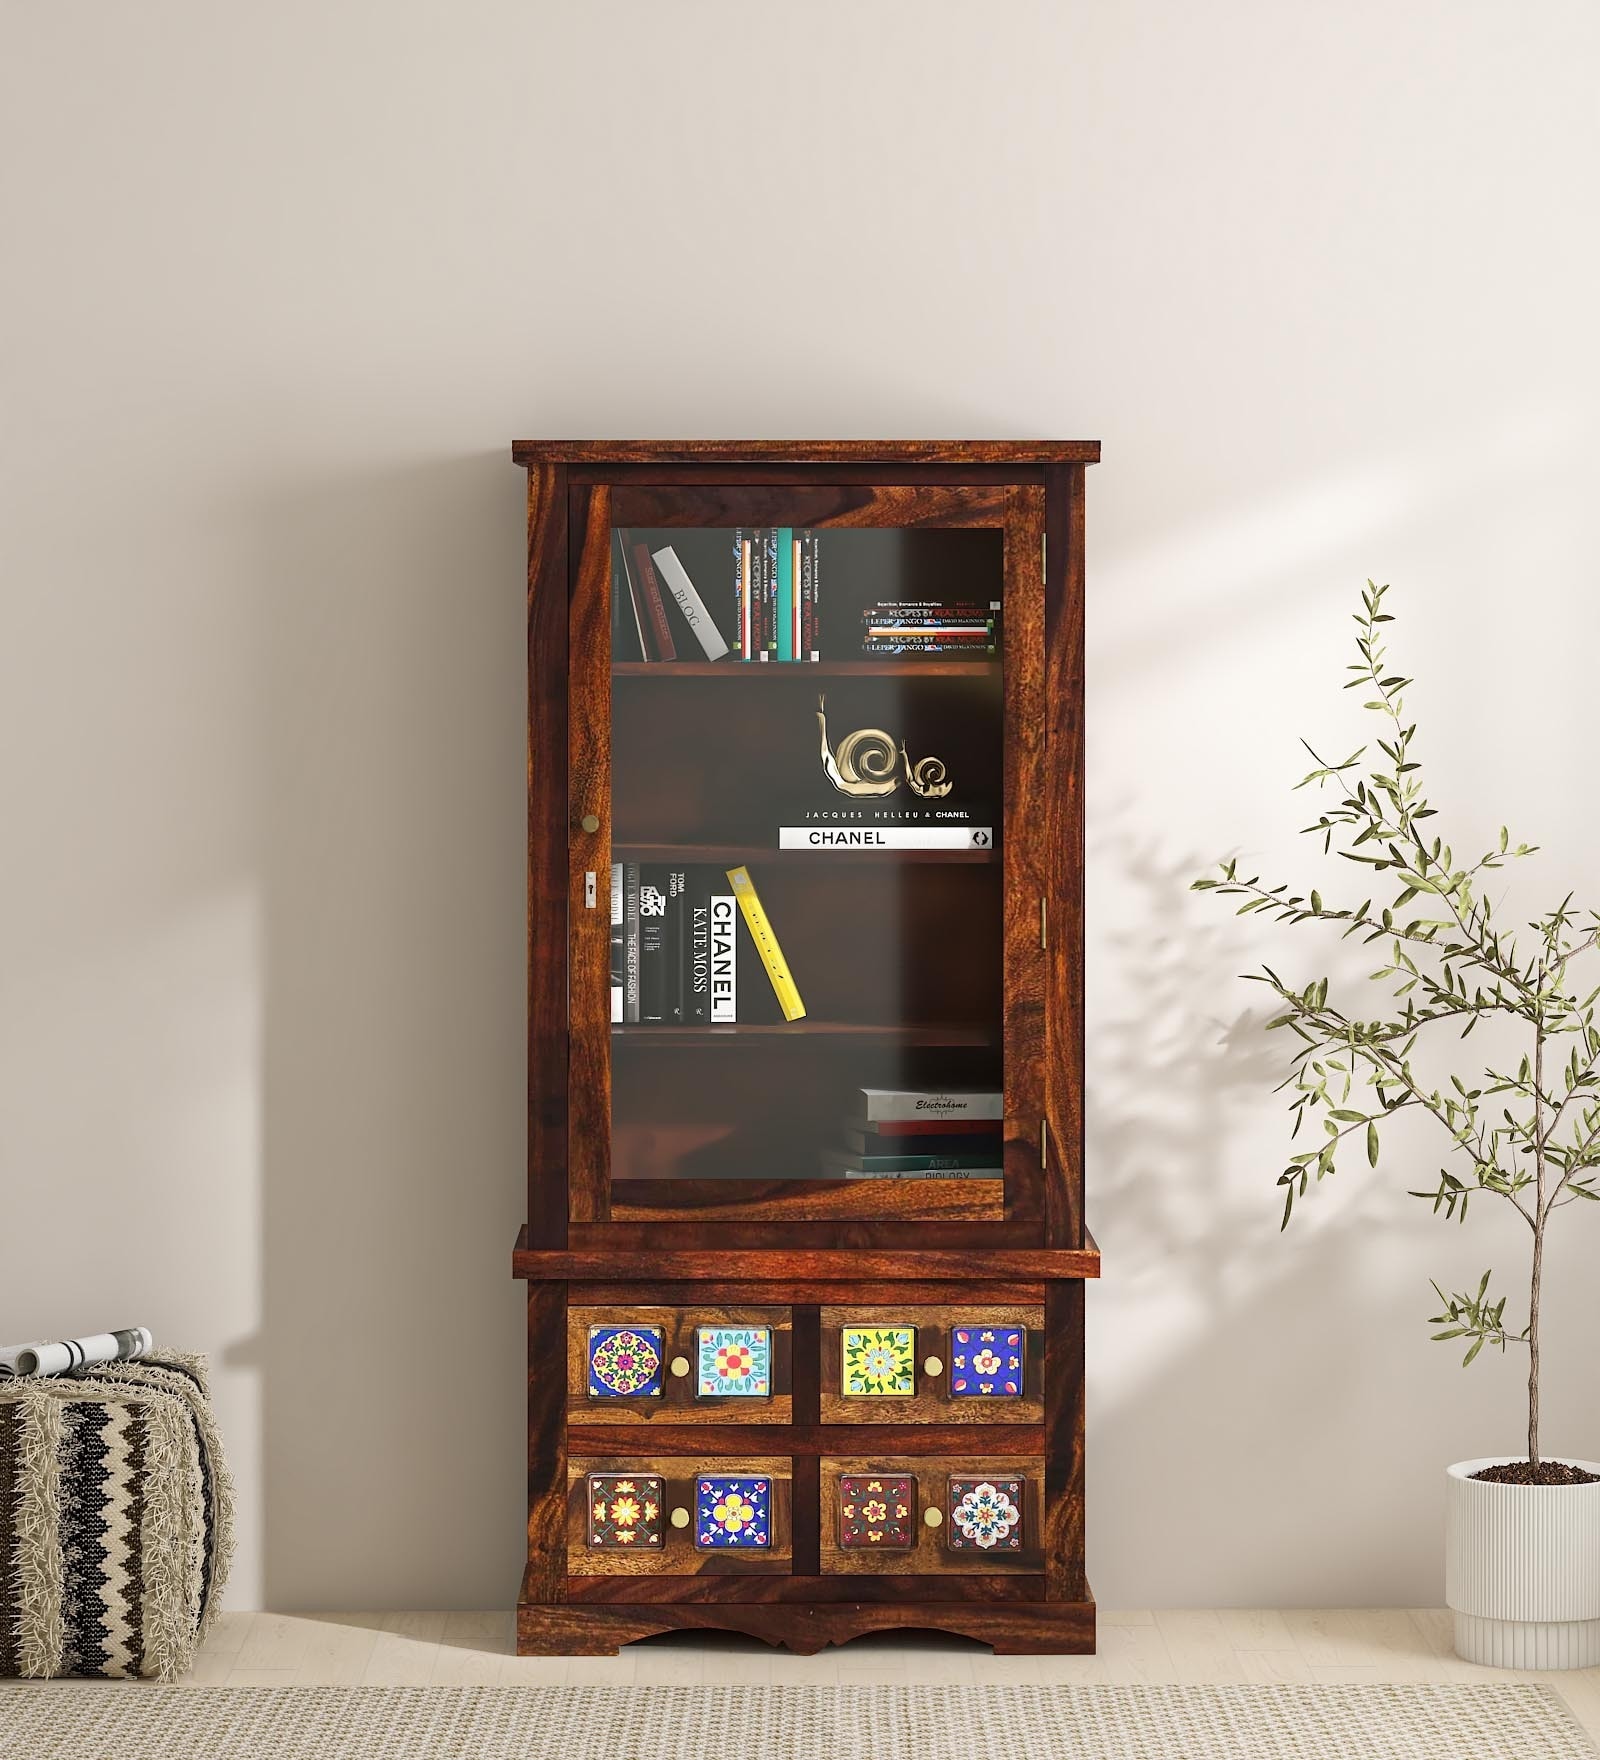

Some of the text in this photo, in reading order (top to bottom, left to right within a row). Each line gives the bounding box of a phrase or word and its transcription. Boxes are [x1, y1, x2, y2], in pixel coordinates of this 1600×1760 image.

[674, 589, 700, 627] BLOG
[805, 811, 863, 819] JACQUES
[809, 831, 886, 845] CHANEL
[627, 893, 636, 922] MODEL
[693, 907, 707, 993] KATE MOSS
[713, 902, 732, 1010] CHANEL
[627, 933, 636, 1004] THE FACE OF FASHION
[915, 1099, 967, 1110] Electrohome
[928, 1159, 960, 1169] AREA
